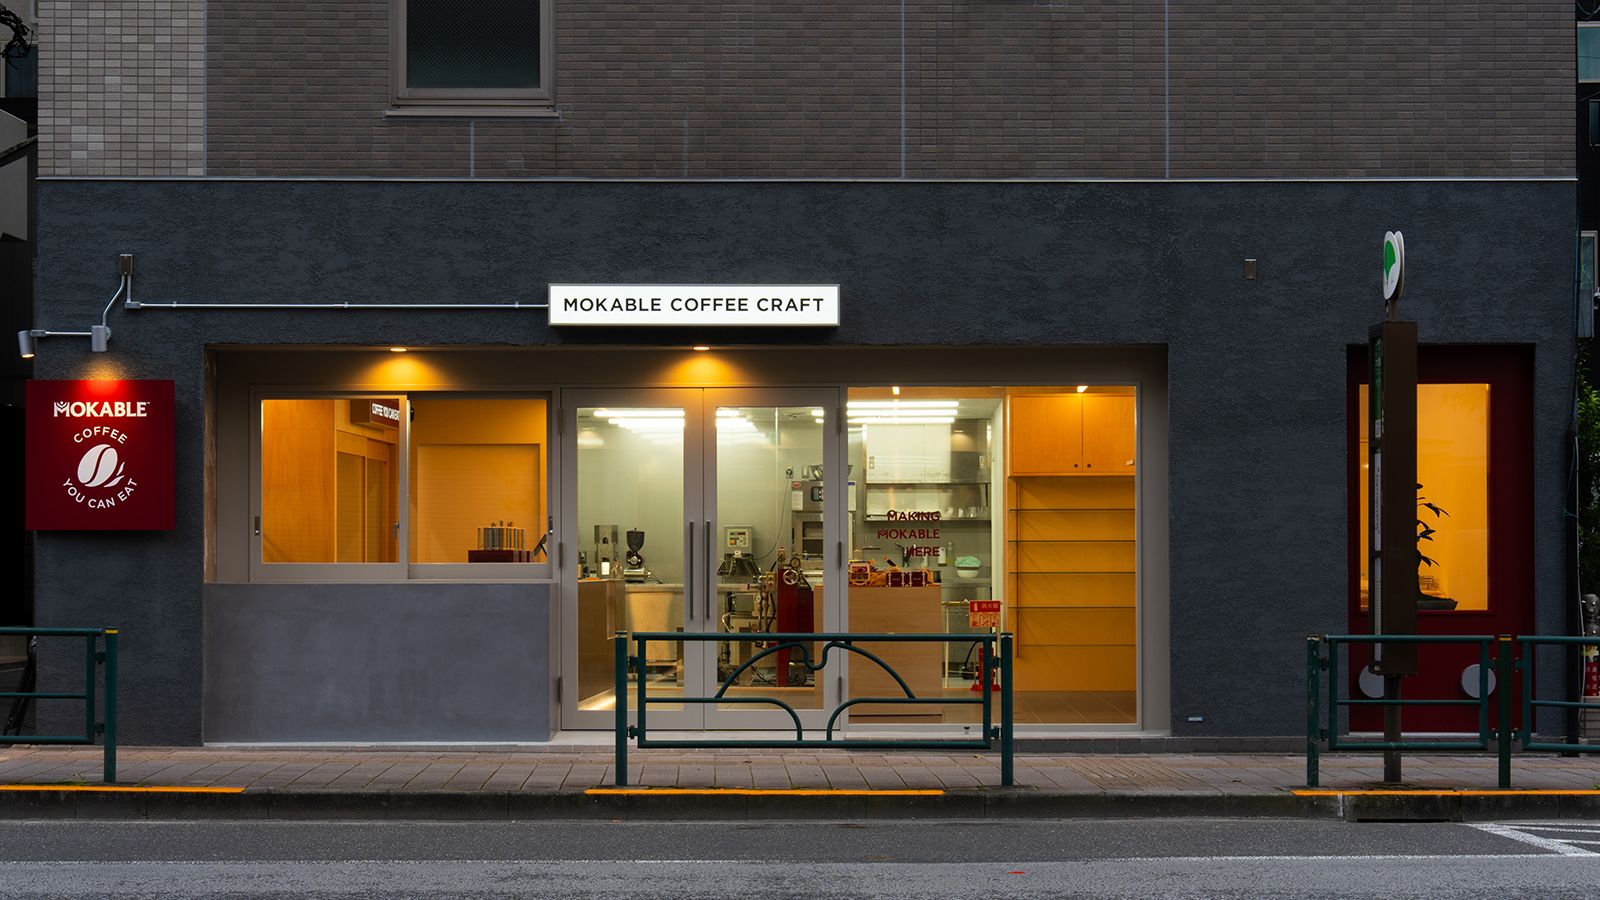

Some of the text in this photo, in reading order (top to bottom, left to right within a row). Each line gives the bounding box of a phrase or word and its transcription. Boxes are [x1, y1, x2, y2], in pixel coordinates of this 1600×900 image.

[563, 298, 824, 311] MOKABLE COFFEE CRAFT
[73, 426, 128, 444] COFFEE
[63, 478, 138, 509] YOU CAN EAT
[887, 510, 940, 521] MAKING
[877, 528, 940, 539] MOKABLE
[906, 546, 940, 557] HERE
